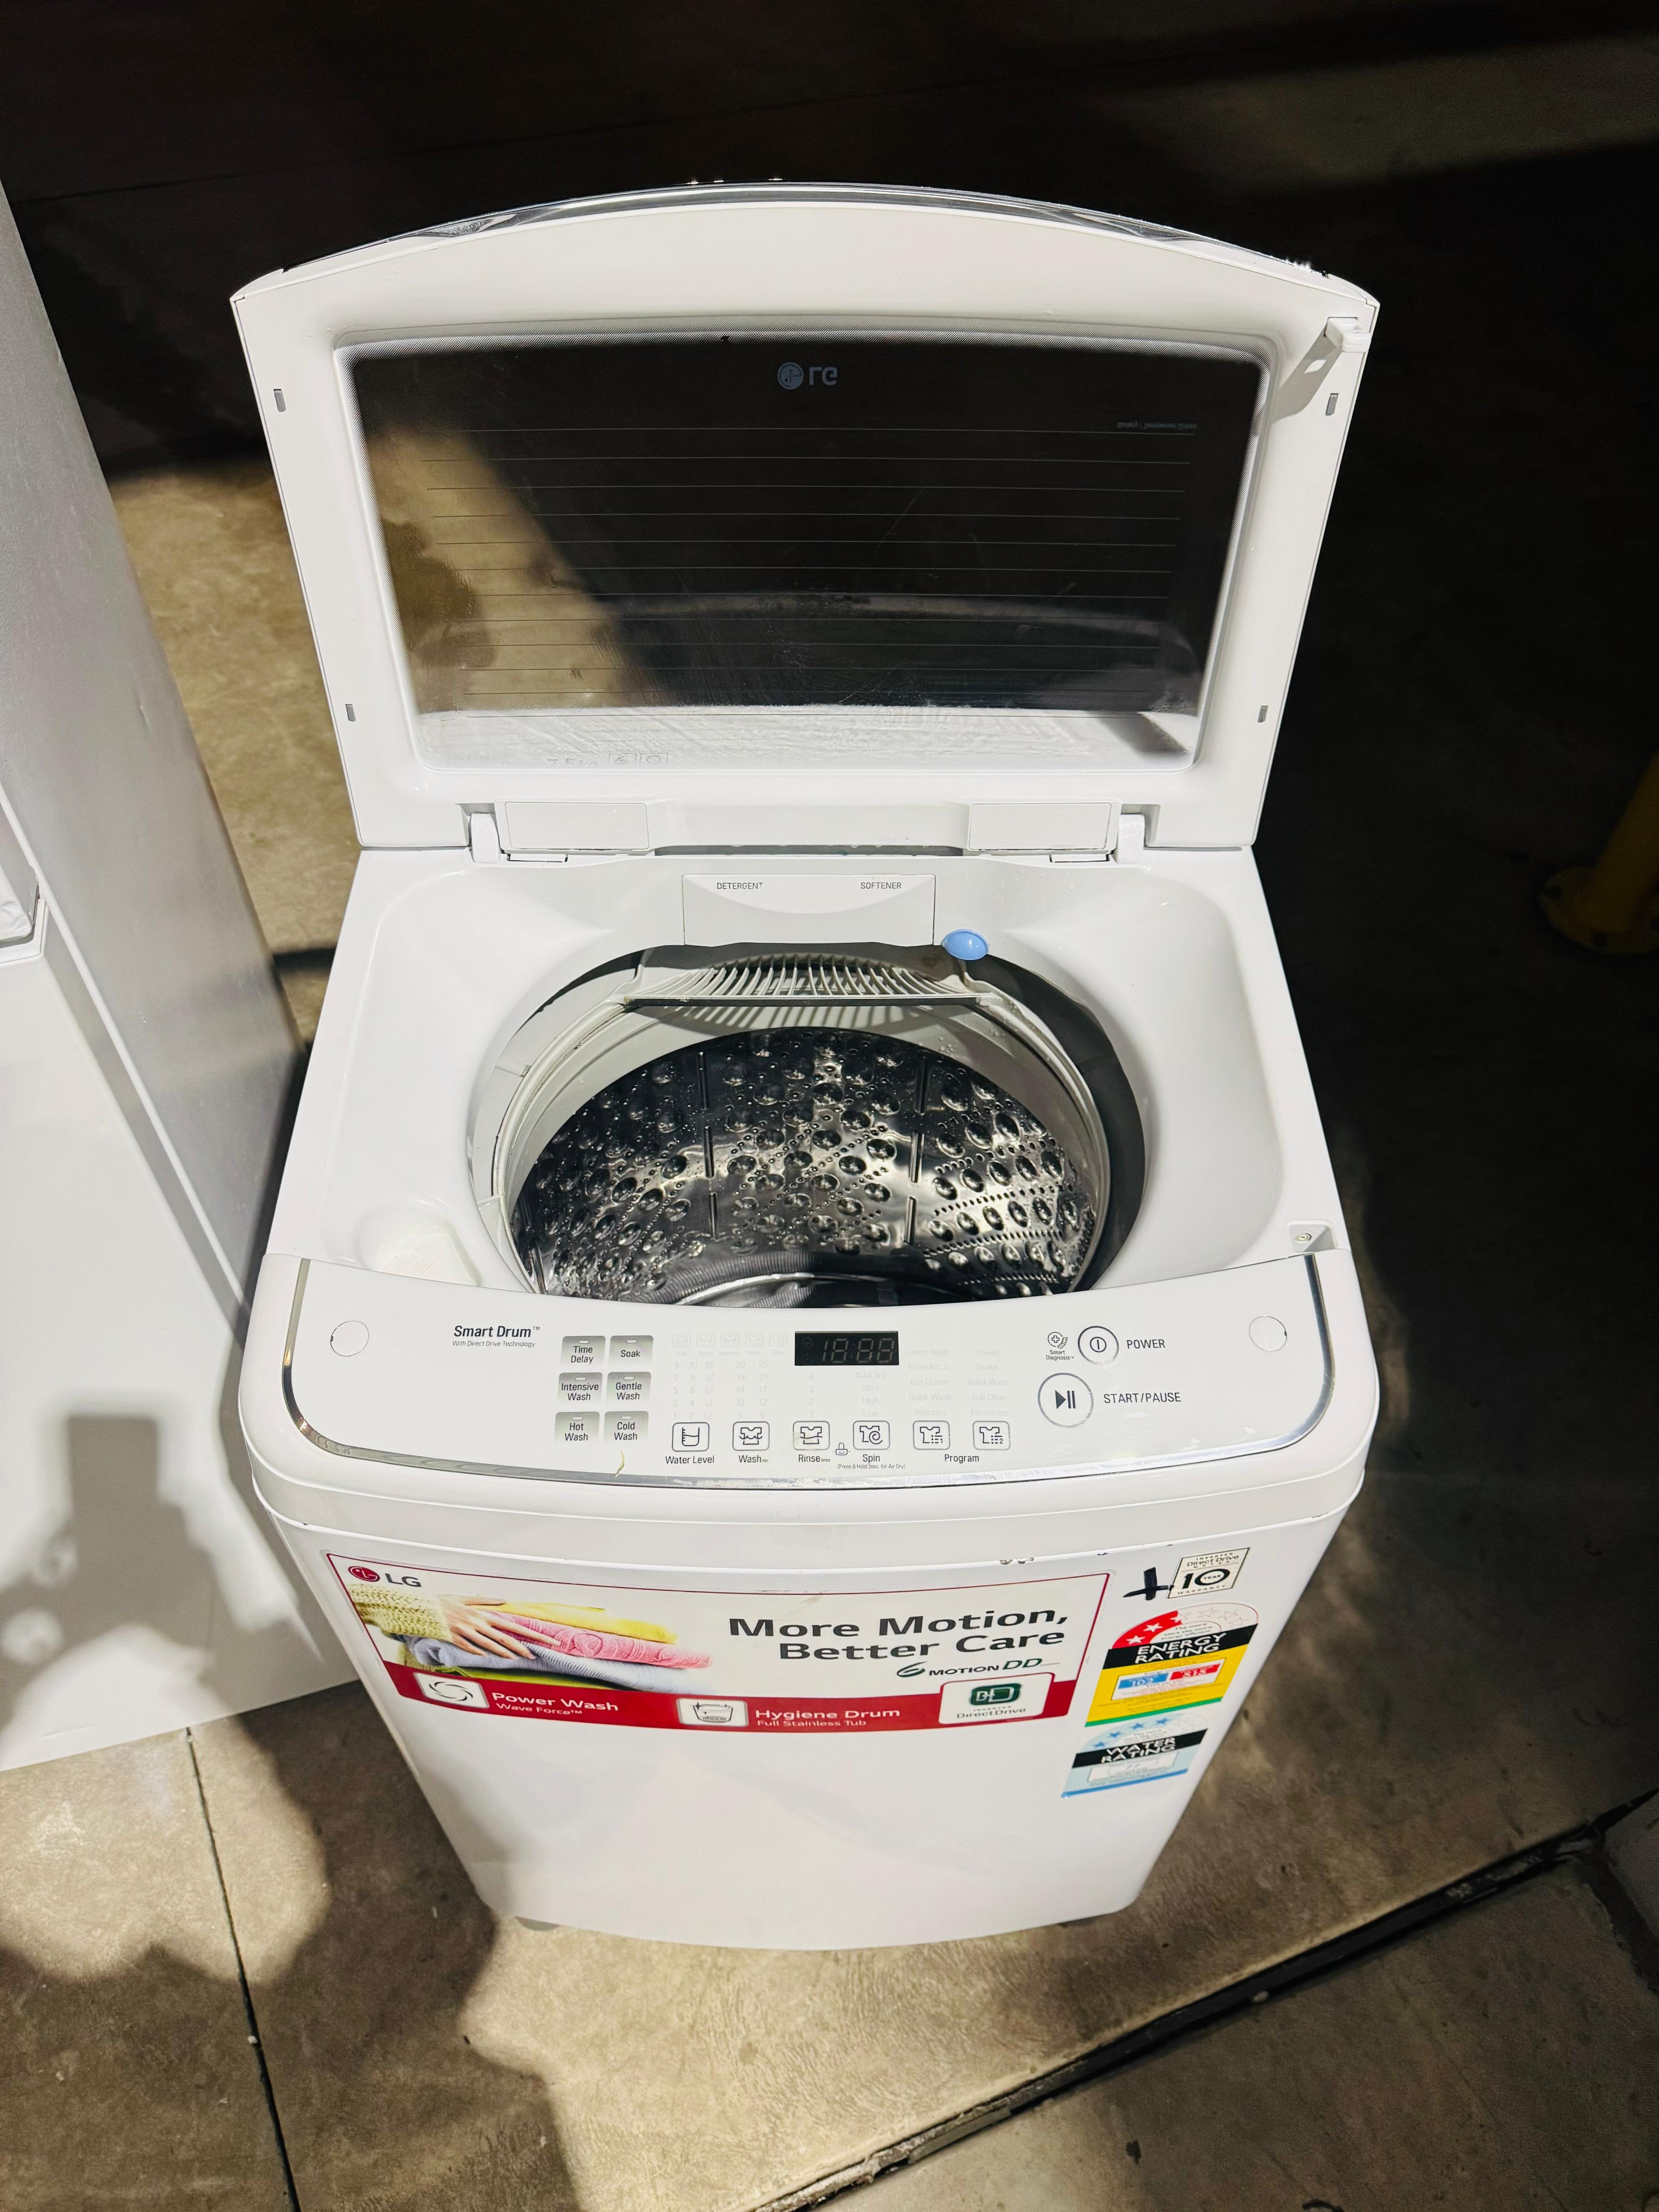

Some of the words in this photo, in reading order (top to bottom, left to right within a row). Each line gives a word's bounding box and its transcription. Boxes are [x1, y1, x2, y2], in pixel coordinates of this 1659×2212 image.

[454, 1325, 493, 1337] Smart
[1127, 1339, 1165, 1349] POWER
[571, 1355, 594, 1364] Delay
[1104, 1392, 1181, 1404] START/PAUSE
[665, 1456, 690, 1464] Water
[693, 1456, 714, 1464] Level
[798, 1454, 820, 1462] Rinse
[863, 1454, 880, 1464] Spin
[944, 1453, 979, 1463] Program
[385, 1573, 422, 1587] LG
[1182, 1568, 1230, 1589] 10
[729, 1618, 859, 1638] More
[879, 1606, 1068, 1635] Motion,
[780, 1642, 940, 1660] Better
[956, 1631, 1065, 1653] Care
[1137, 1632, 1227, 1655] ENERGY
[1135, 1643, 1220, 1665] RATING
[929, 1665, 999, 1676] MOTION
[1002, 1658, 1043, 1670] DD
[492, 1692, 556, 1706] Power
[561, 1698, 618, 1711] Wash
[496, 1703, 532, 1711] Wave
[756, 1710, 838, 1720] Hygiene
[845, 1710, 900, 1719] Drum
[1106, 1737, 1176, 1756] WATER
[1100, 1745, 1176, 1764] RATING
